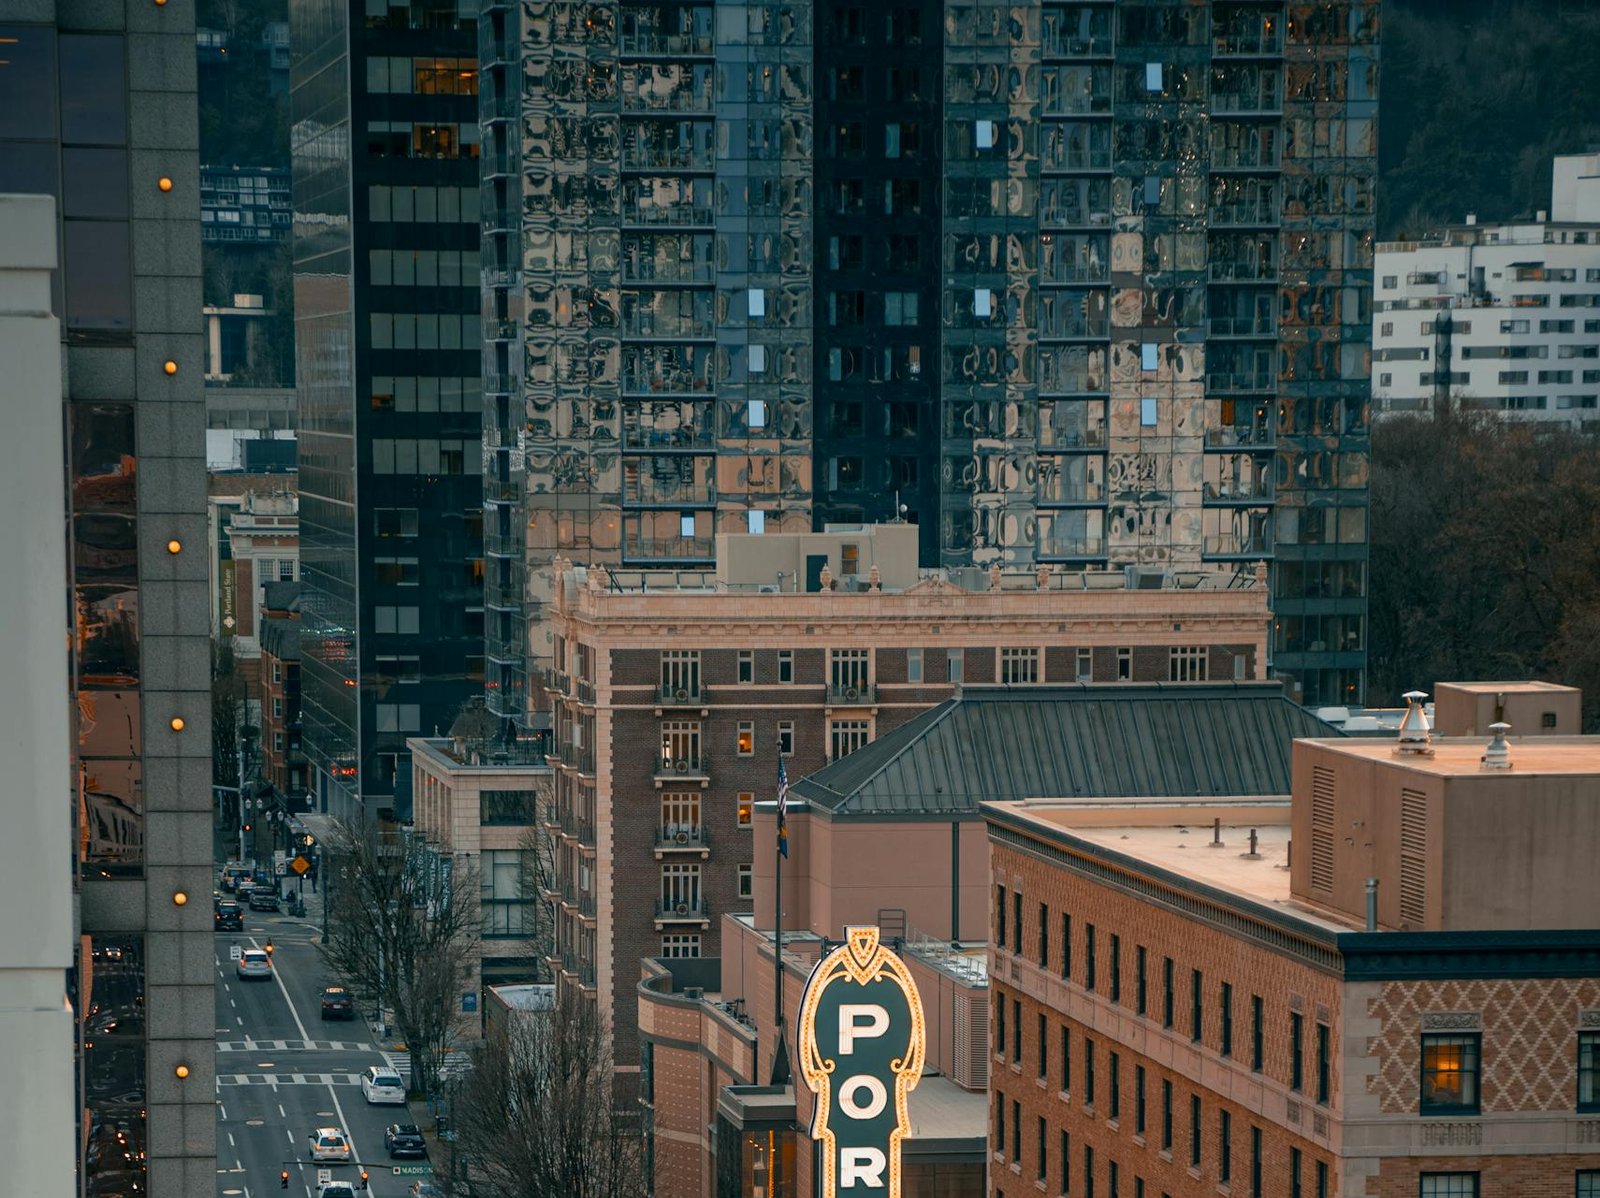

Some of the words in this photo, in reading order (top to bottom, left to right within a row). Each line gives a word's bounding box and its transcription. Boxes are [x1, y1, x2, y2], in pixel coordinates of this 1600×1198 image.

[224, 568, 232, 586] State
[224, 587, 232, 615] Portland
[402, 1166, 434, 1174] MADISON
